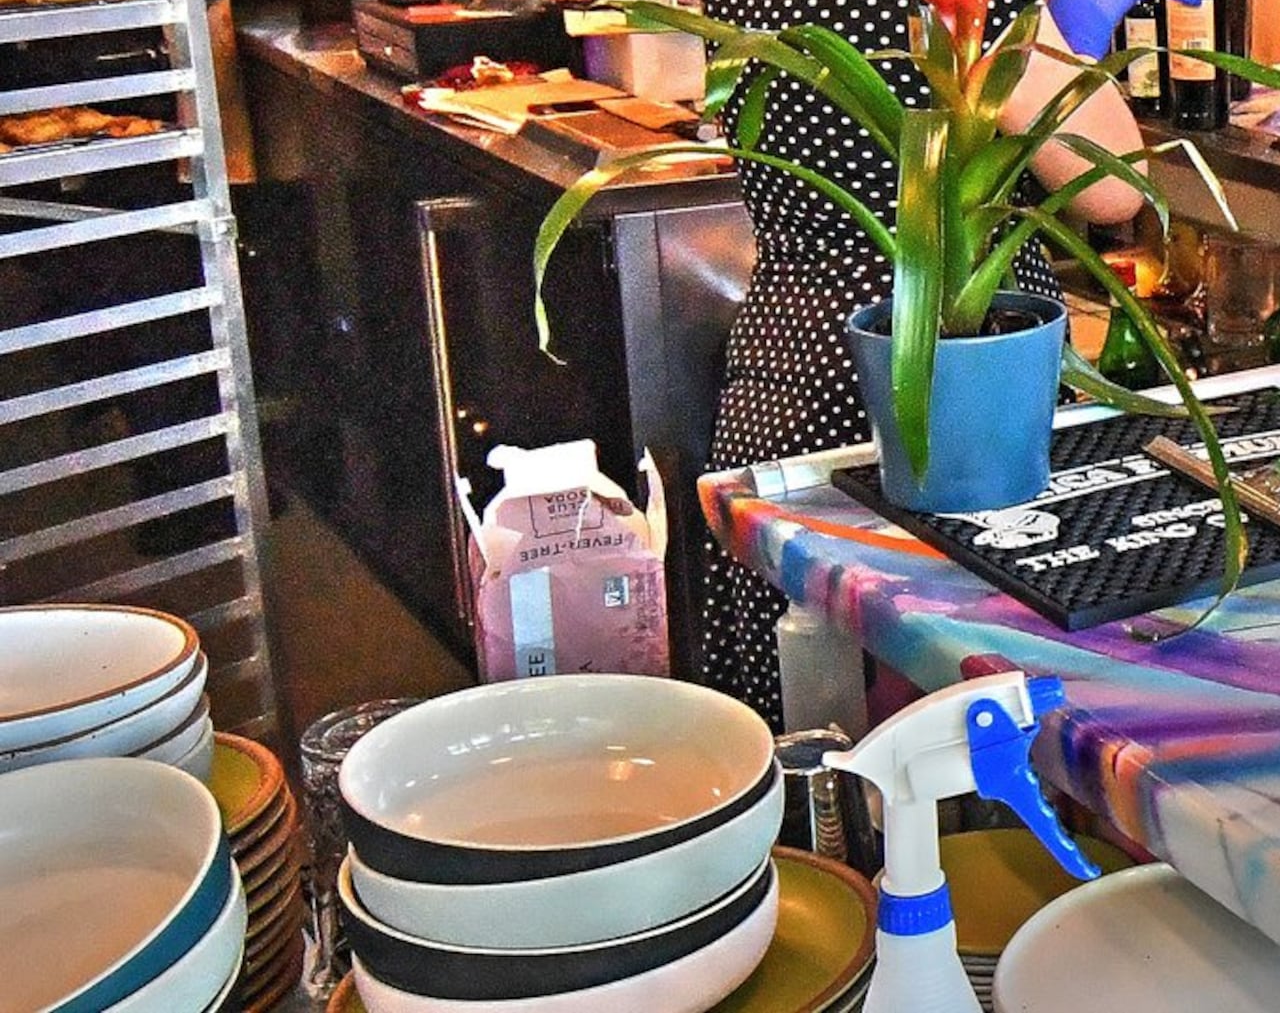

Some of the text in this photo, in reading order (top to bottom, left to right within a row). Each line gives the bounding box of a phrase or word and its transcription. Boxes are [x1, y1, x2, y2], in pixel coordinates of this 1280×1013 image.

[543, 489, 588, 504] SODA
[519, 533, 624, 563] FEVER-TREE
[1015, 544, 1101, 572] THE
[1104, 522, 1197, 553] KING
